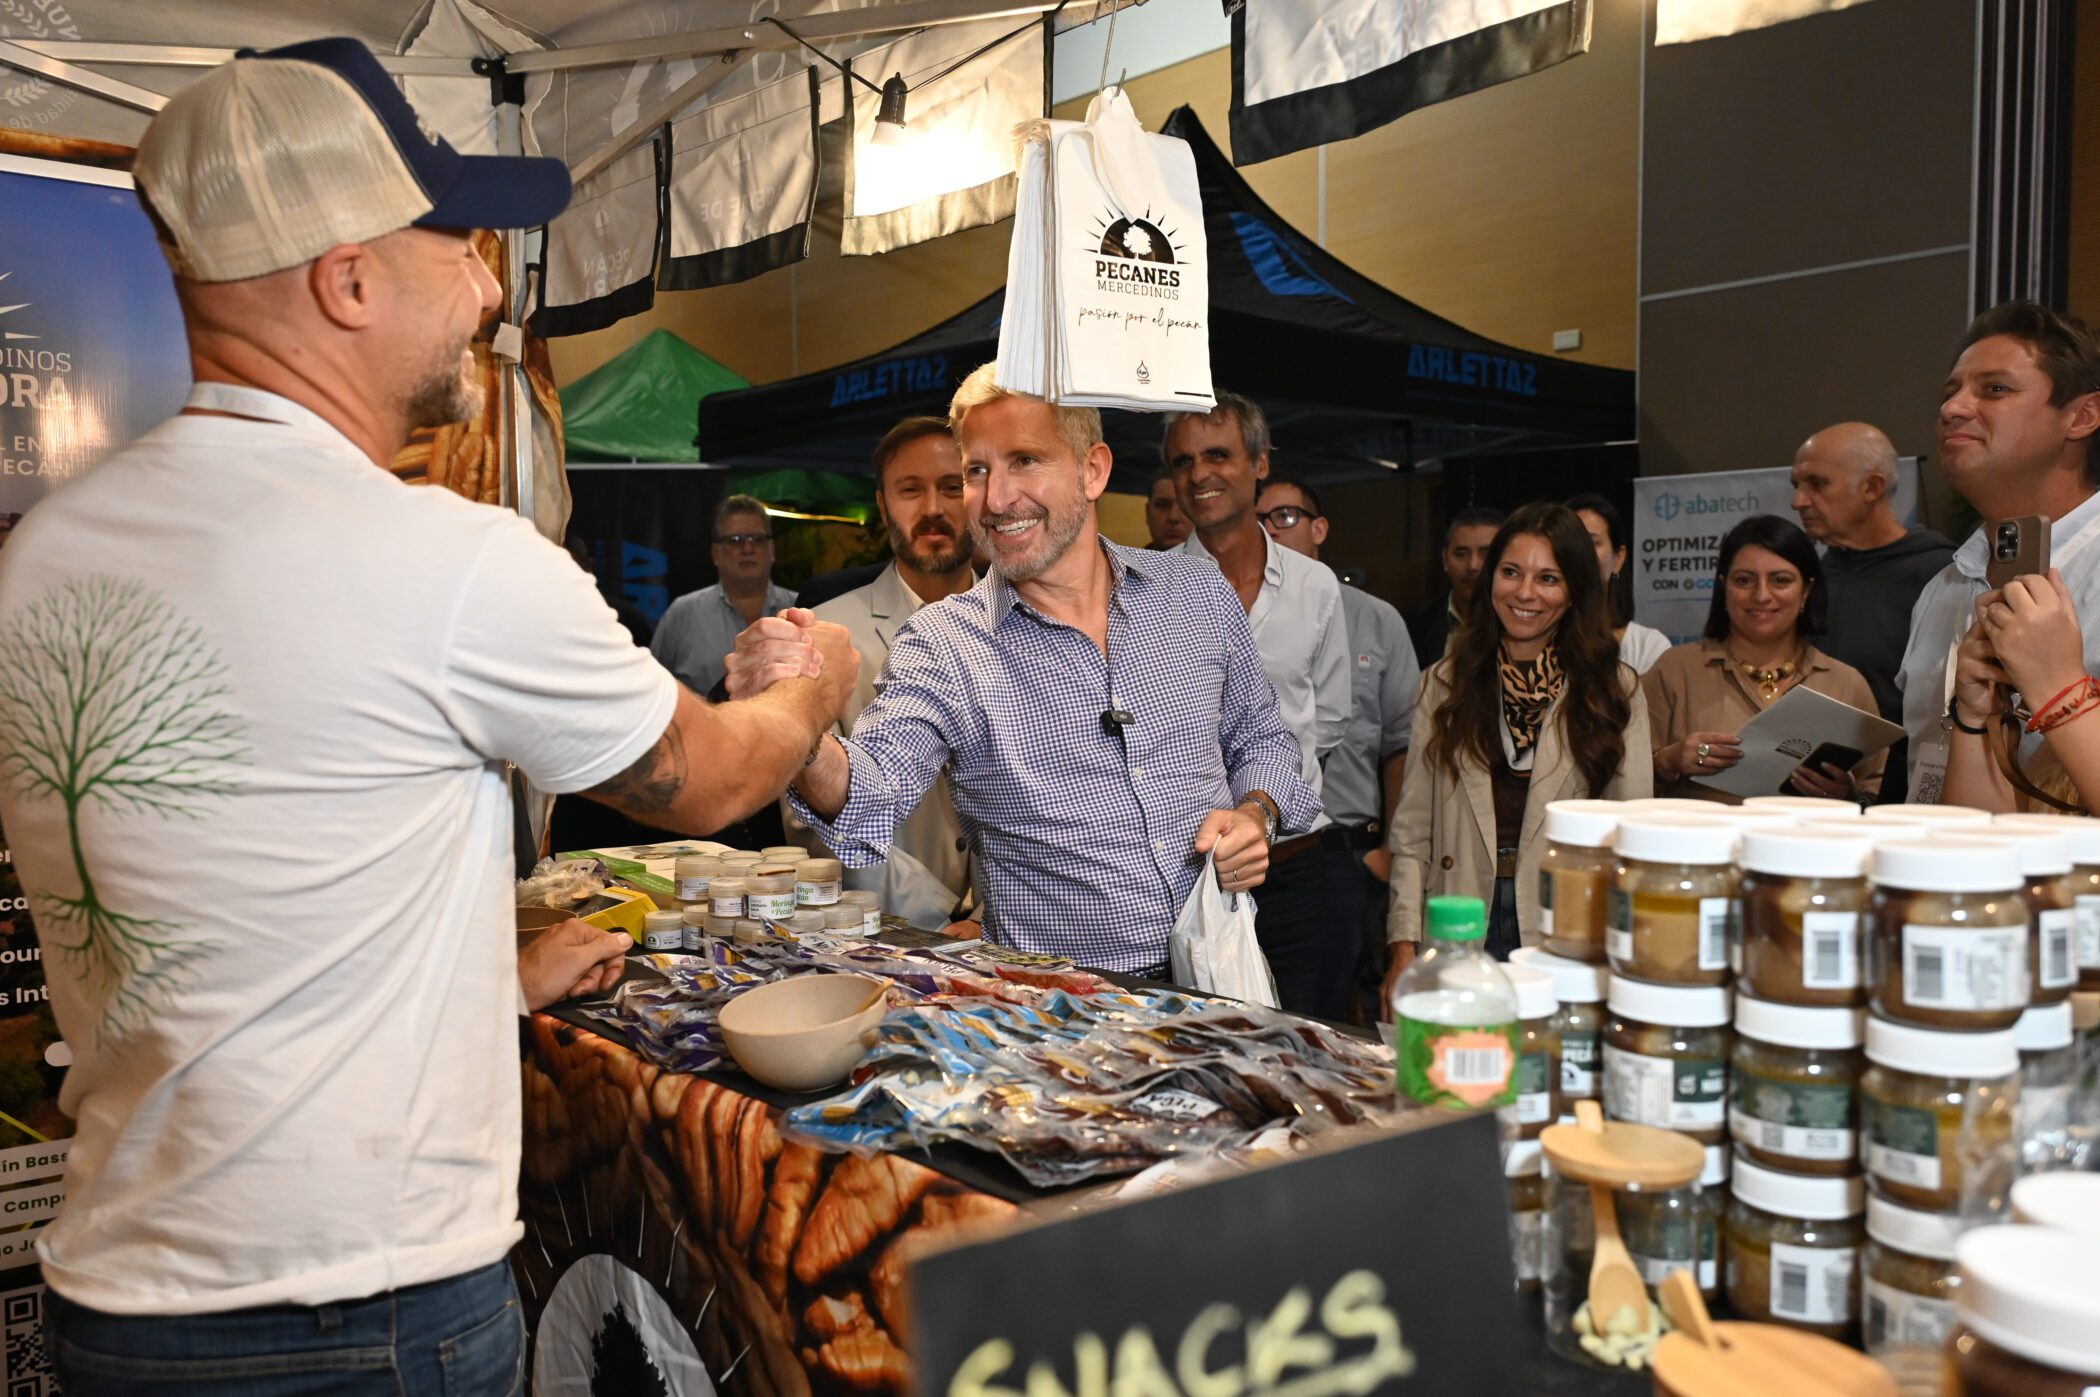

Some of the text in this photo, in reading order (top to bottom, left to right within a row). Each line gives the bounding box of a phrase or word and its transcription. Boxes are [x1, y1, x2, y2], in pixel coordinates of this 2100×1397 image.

[1095, 260, 1180, 288] PECANES
[1097, 279, 1179, 301] MERCEDINOS
[1125, 312, 1147, 332] por
[1152, 307, 1164, 327] el
[1685, 490, 1759, 515] abatech
[1642, 557, 1654, 573] Y
[1652, 579, 1679, 591] CON
